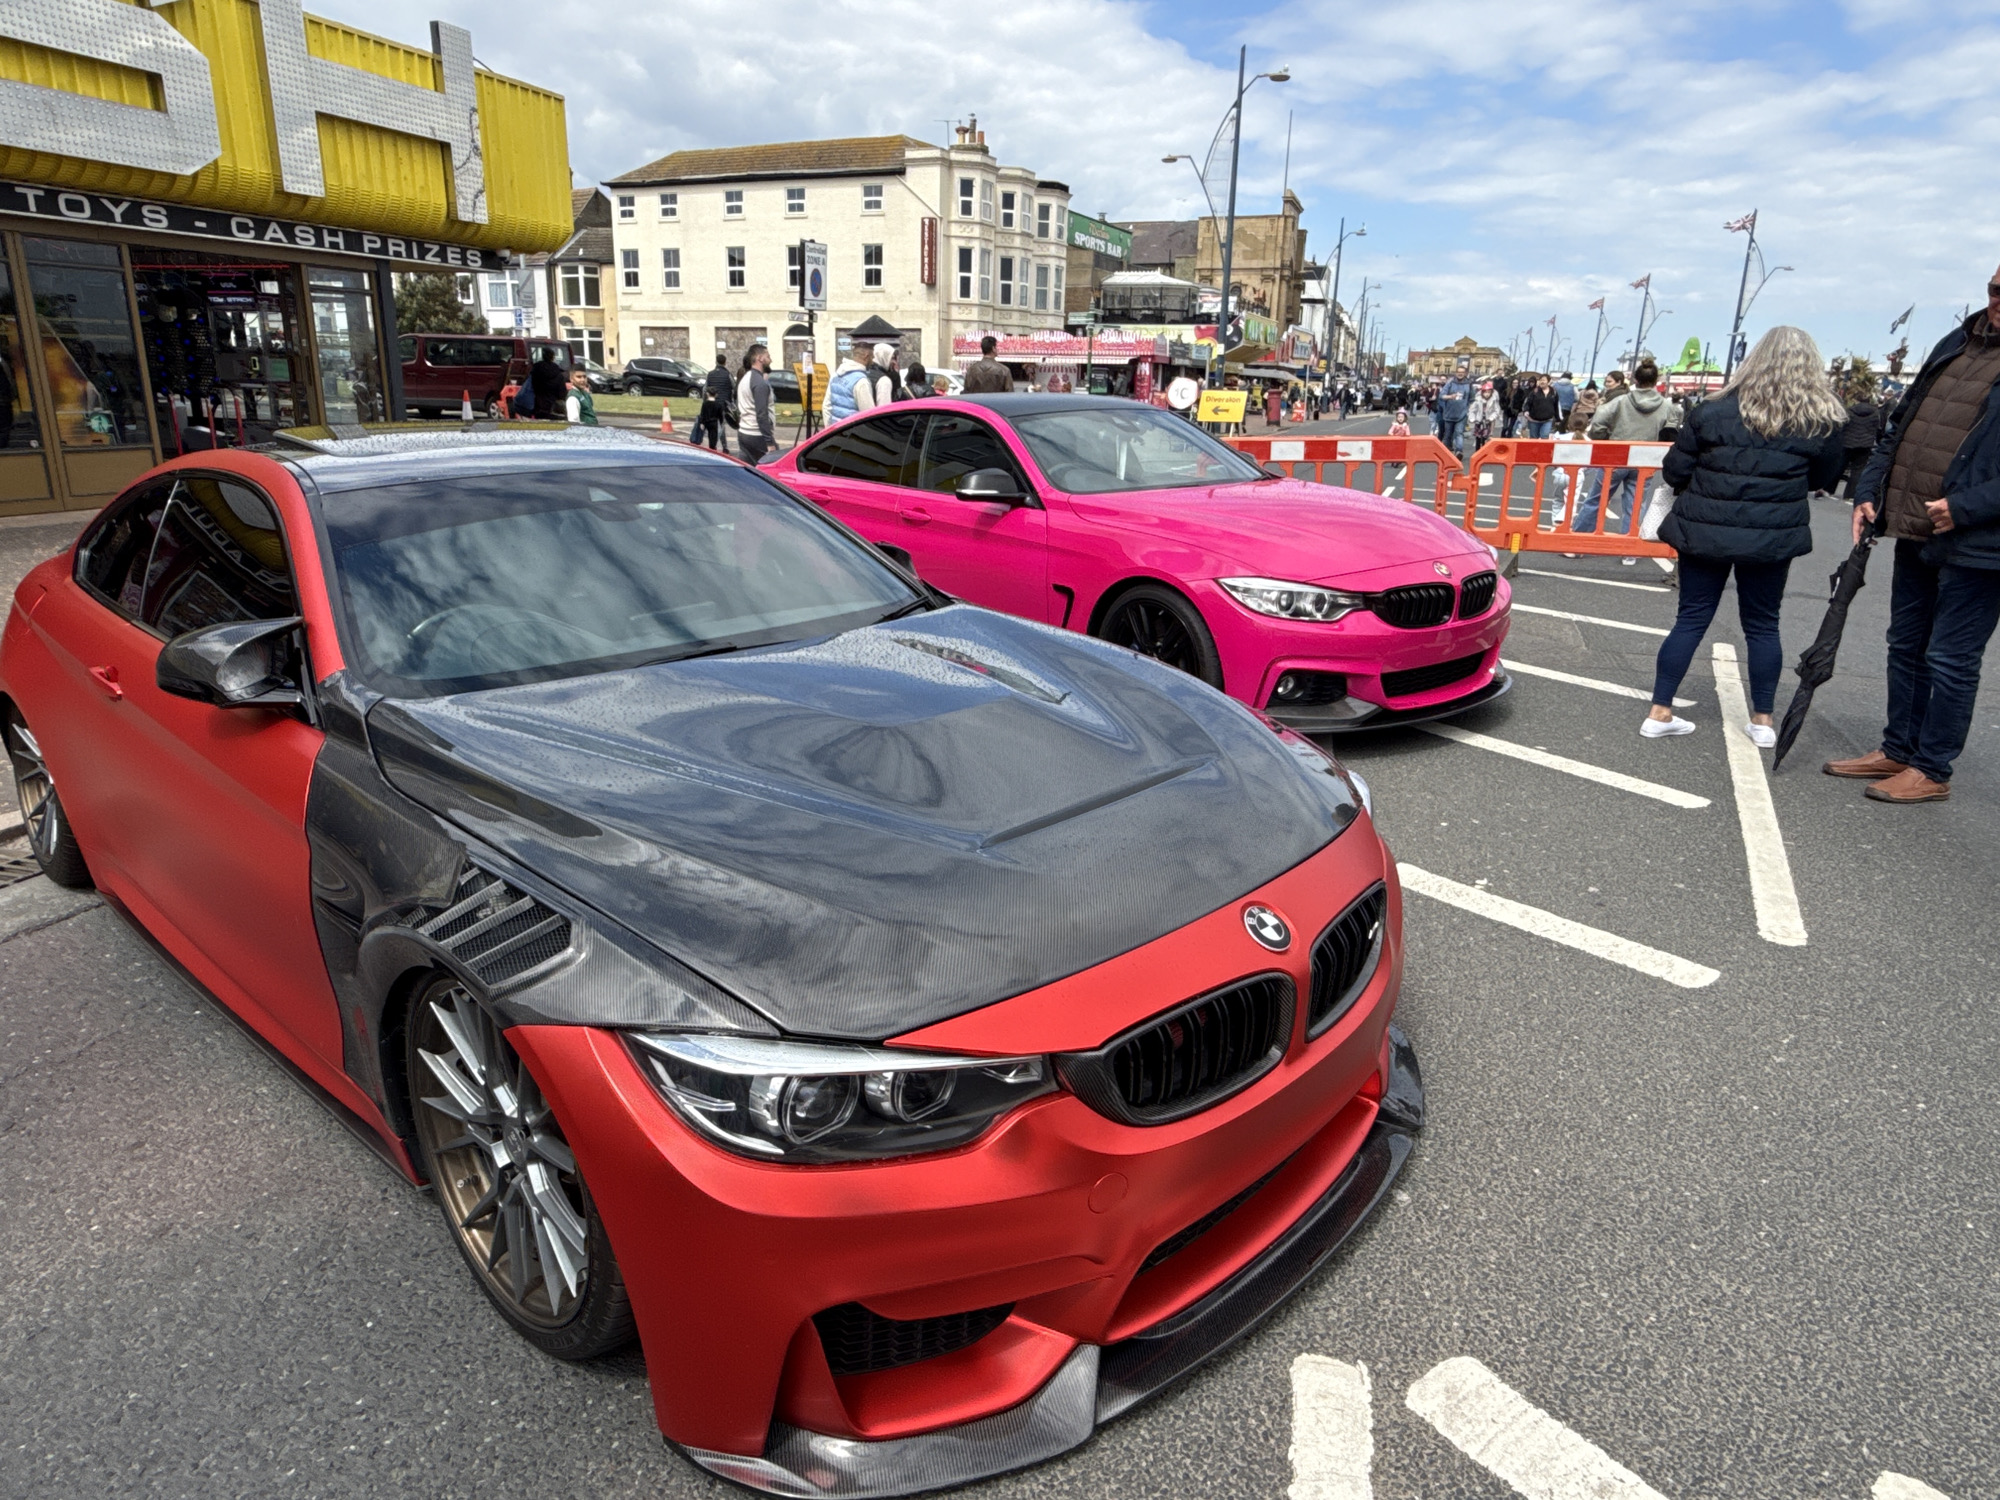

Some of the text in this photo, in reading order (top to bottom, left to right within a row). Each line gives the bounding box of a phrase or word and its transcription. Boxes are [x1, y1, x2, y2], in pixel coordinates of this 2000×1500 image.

[15, 186, 169, 229] TOYS
[230, 216, 345, 250] CASH
[363, 234, 482, 268] PRIZES
[1074, 231, 1122, 258] SPORTS BAR
[806, 255, 821, 266] ZONE
[1205, 395, 1241, 403] Diversion
